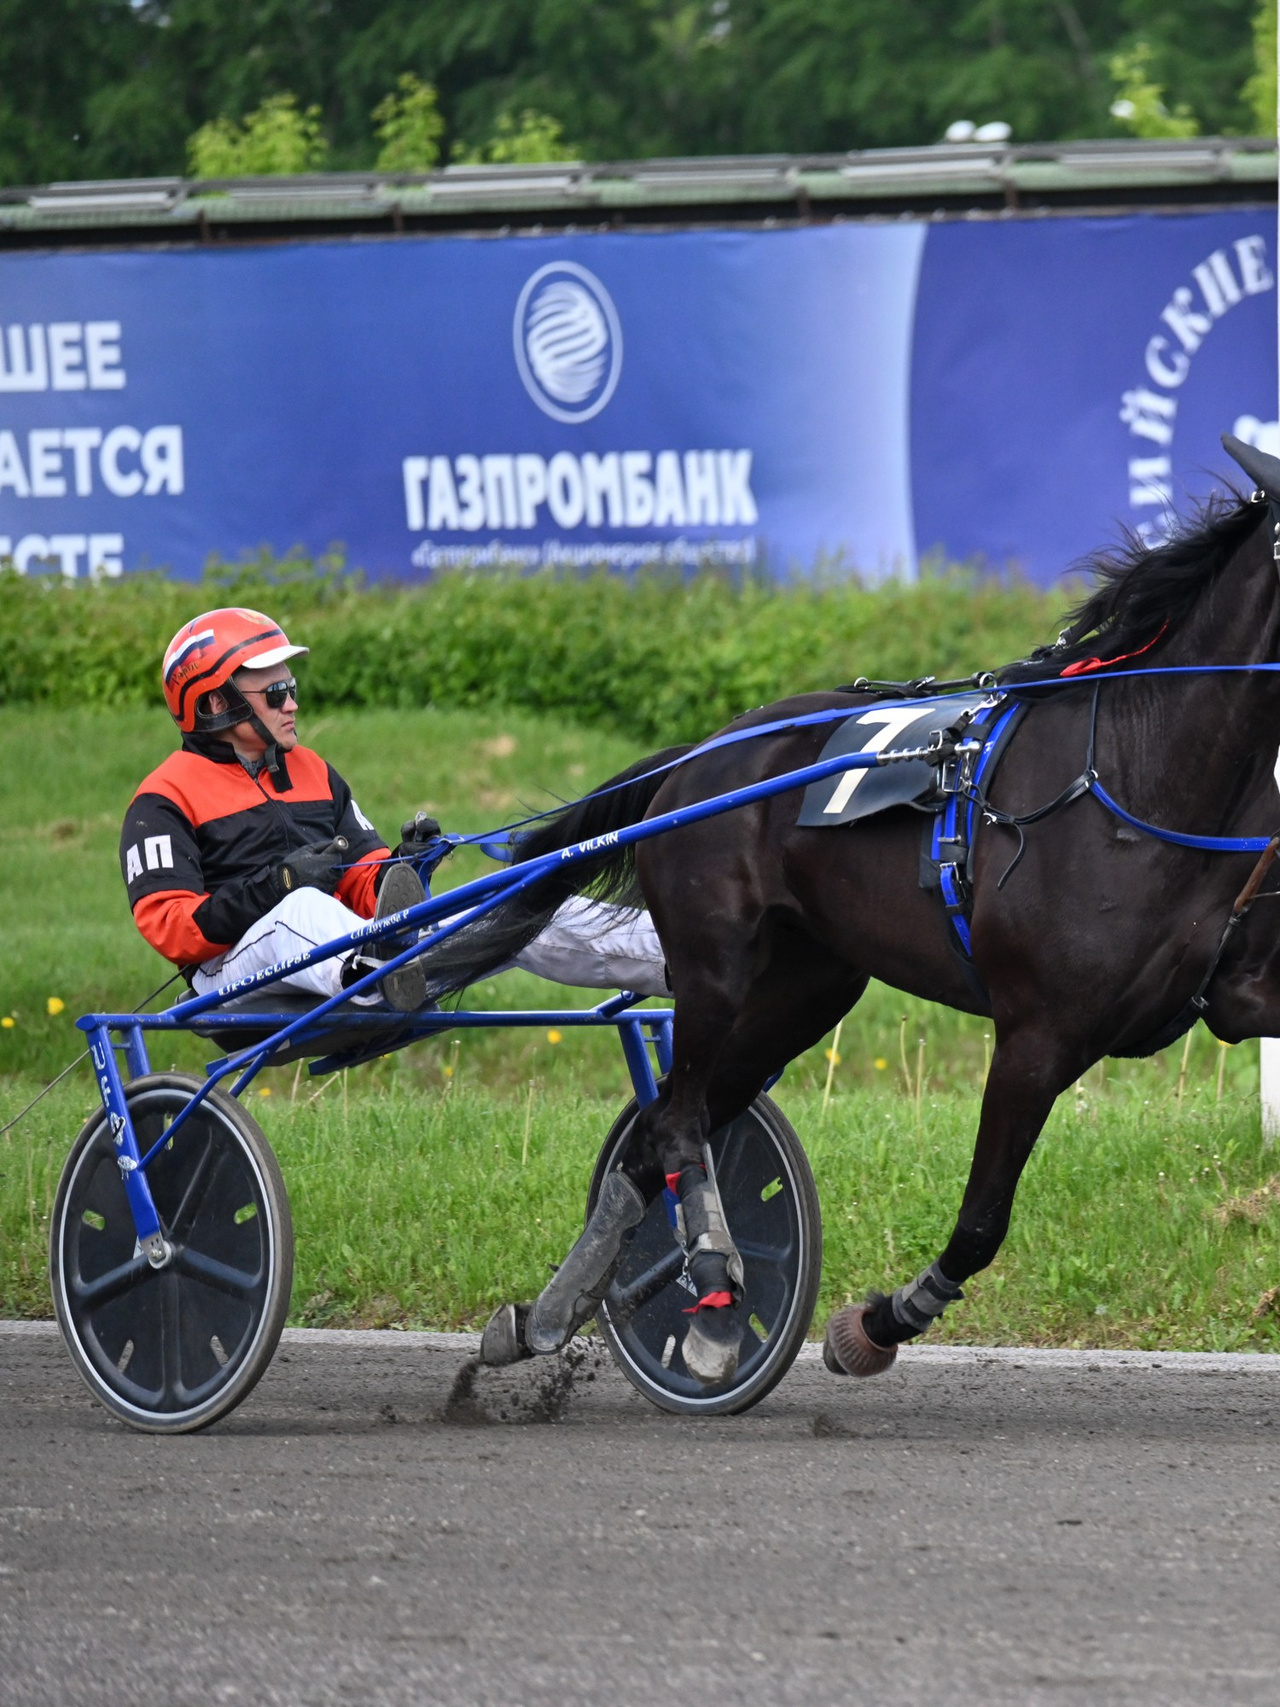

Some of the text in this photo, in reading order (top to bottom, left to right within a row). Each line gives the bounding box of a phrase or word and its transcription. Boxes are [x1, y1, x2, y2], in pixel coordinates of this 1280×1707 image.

[402, 447, 759, 532] ГАЗПРОМБАНК
[825, 707, 936, 814] 7
[126, 834, 174, 885] АП
[578, 831, 619, 853] VILKIN
